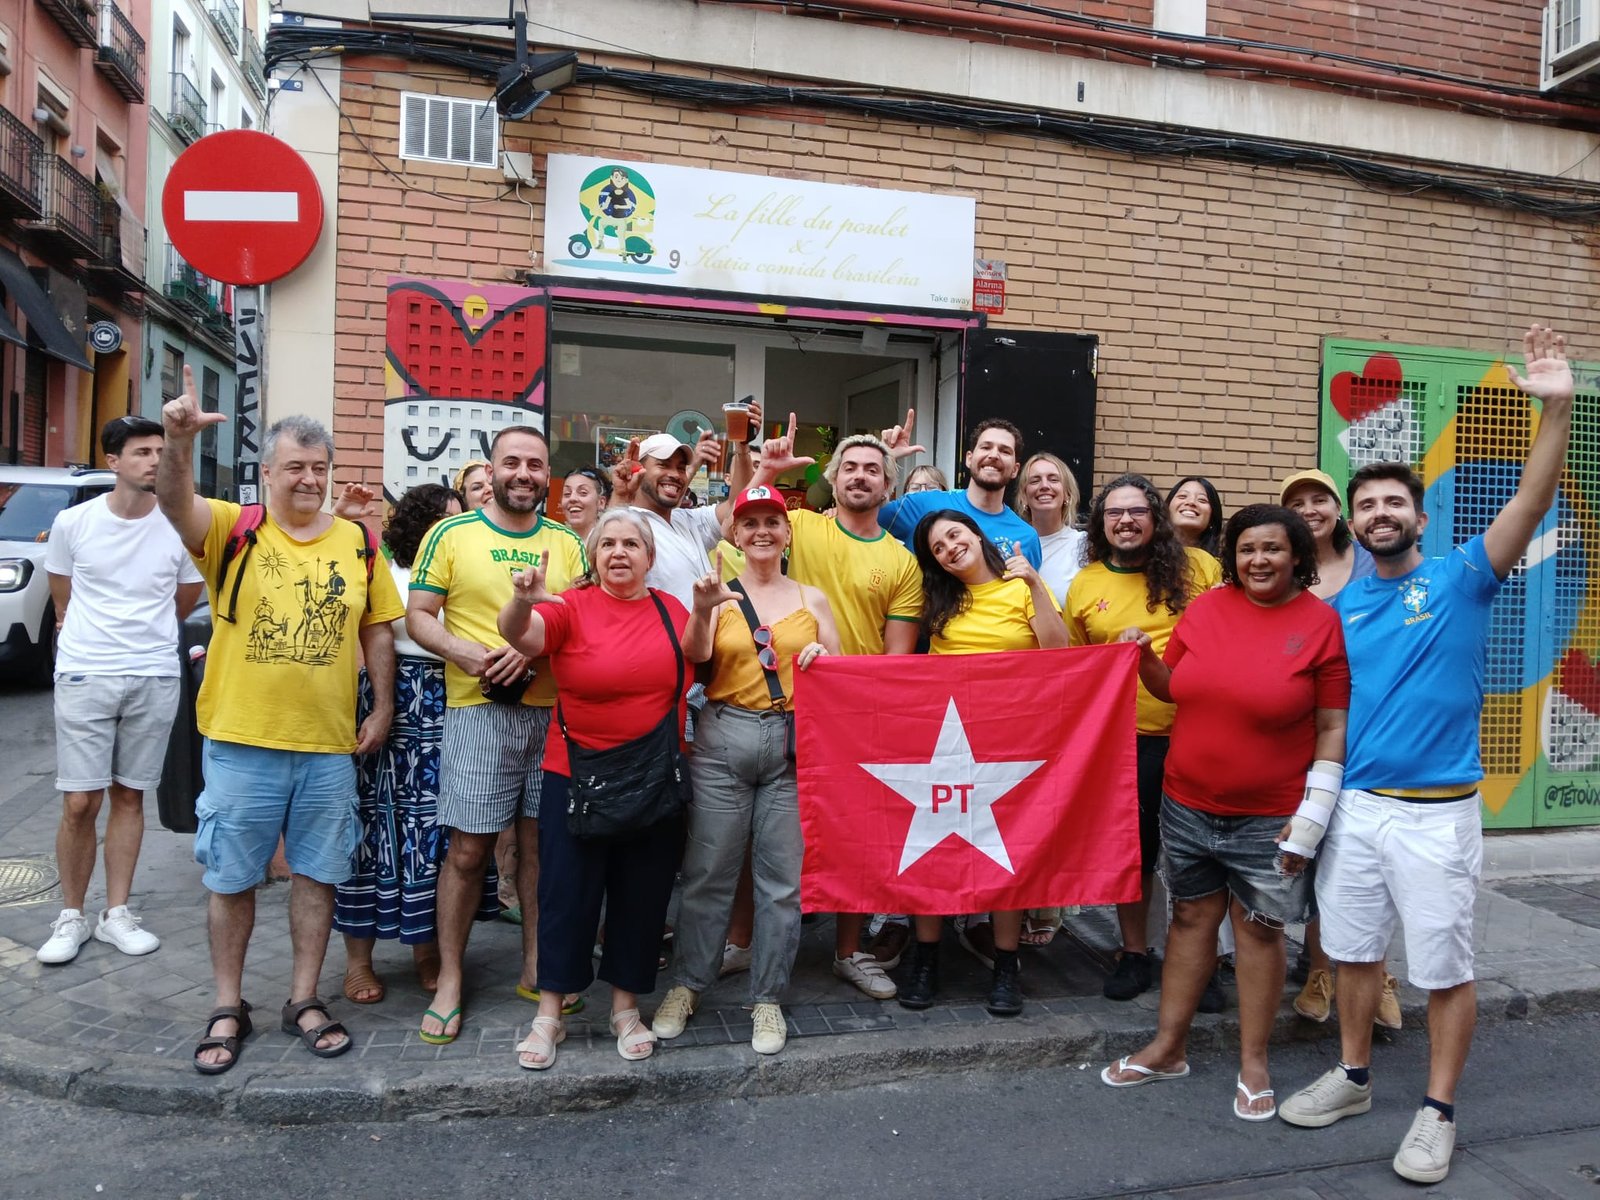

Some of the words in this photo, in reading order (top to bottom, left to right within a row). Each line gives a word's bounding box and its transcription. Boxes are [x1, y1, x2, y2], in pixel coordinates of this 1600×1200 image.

[694, 193, 738, 220] La
[731, 191, 804, 242] fille
[804, 205, 833, 231] du
[825, 205, 910, 250] poulet
[788, 239, 816, 256] &
[668, 249, 681, 269] 9
[756, 256, 828, 279] comida
[975, 280, 1003, 291] Alarma
[930, 293, 949, 304] Take
[950, 297, 971, 307] away
[490, 548, 541, 568] BRASIL
[1404, 612, 1433, 625] BRASIL
[932, 784, 974, 814] PT
